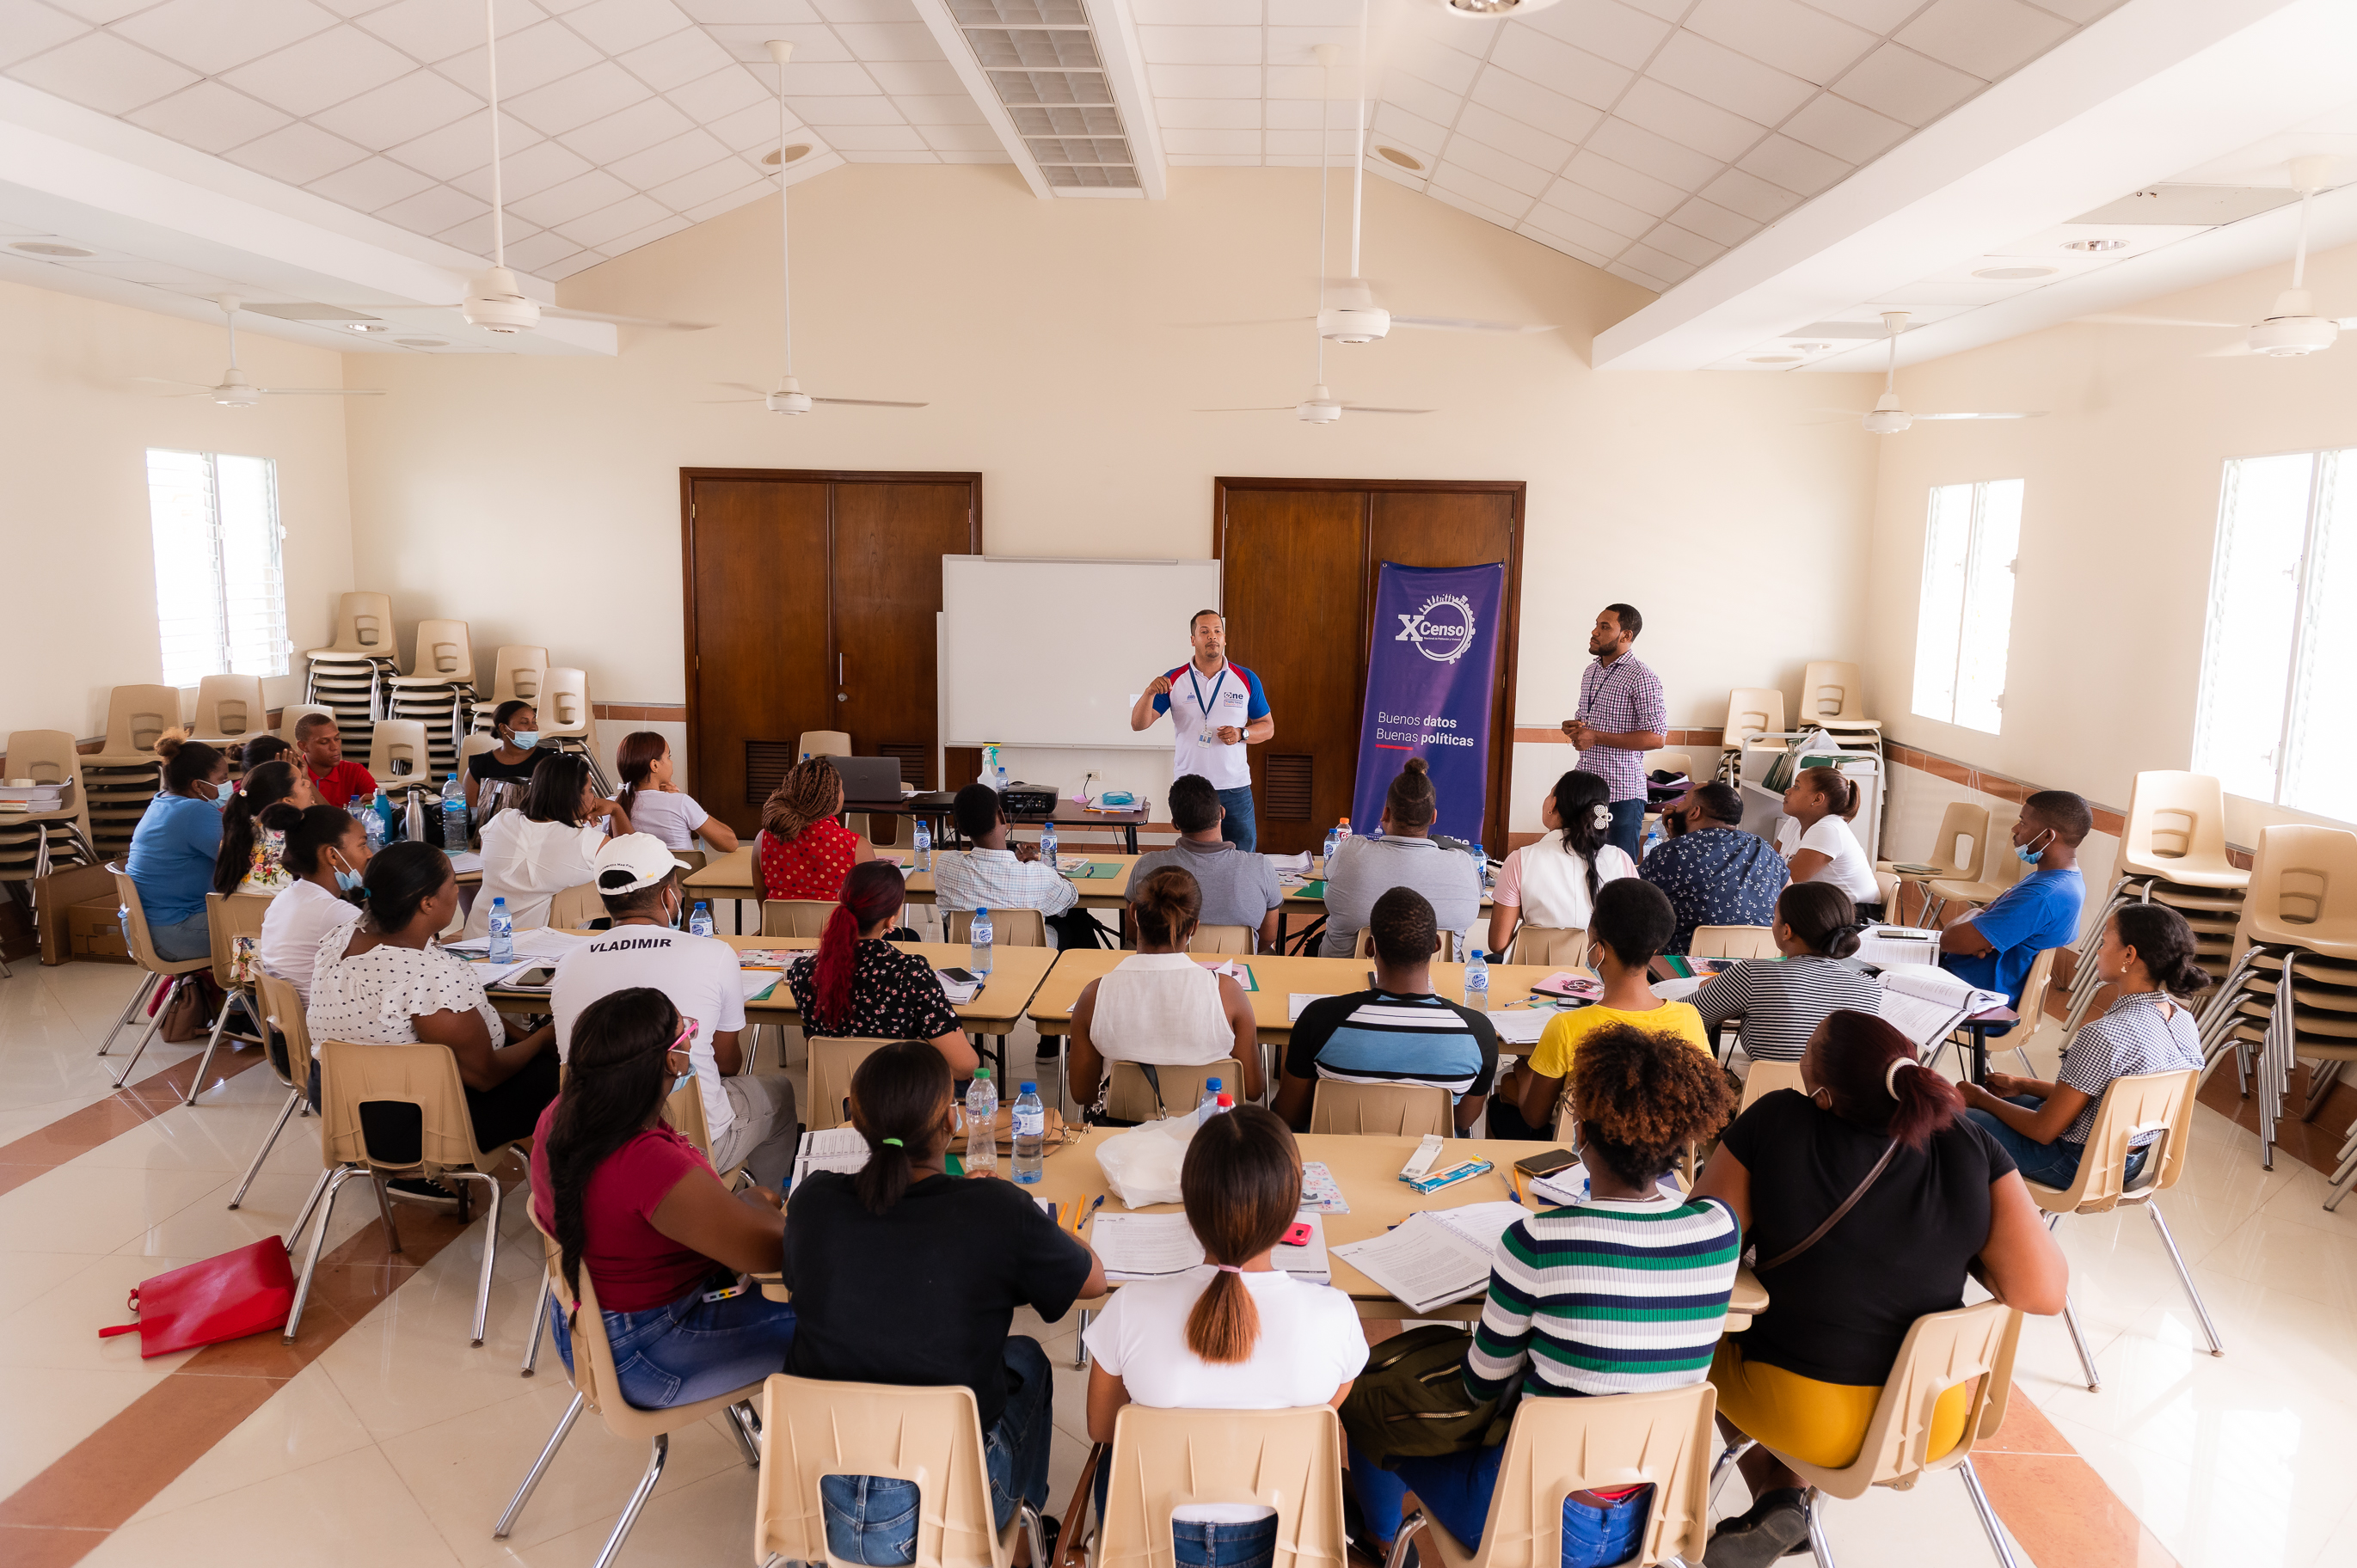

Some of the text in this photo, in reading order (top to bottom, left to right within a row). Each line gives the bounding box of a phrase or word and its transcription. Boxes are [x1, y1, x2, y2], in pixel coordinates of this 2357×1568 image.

[1378, 711, 1458, 729] Buenos datos
[1376, 727, 1475, 747] Buenas políticas
[590, 938, 672, 953] VLADIMIR
